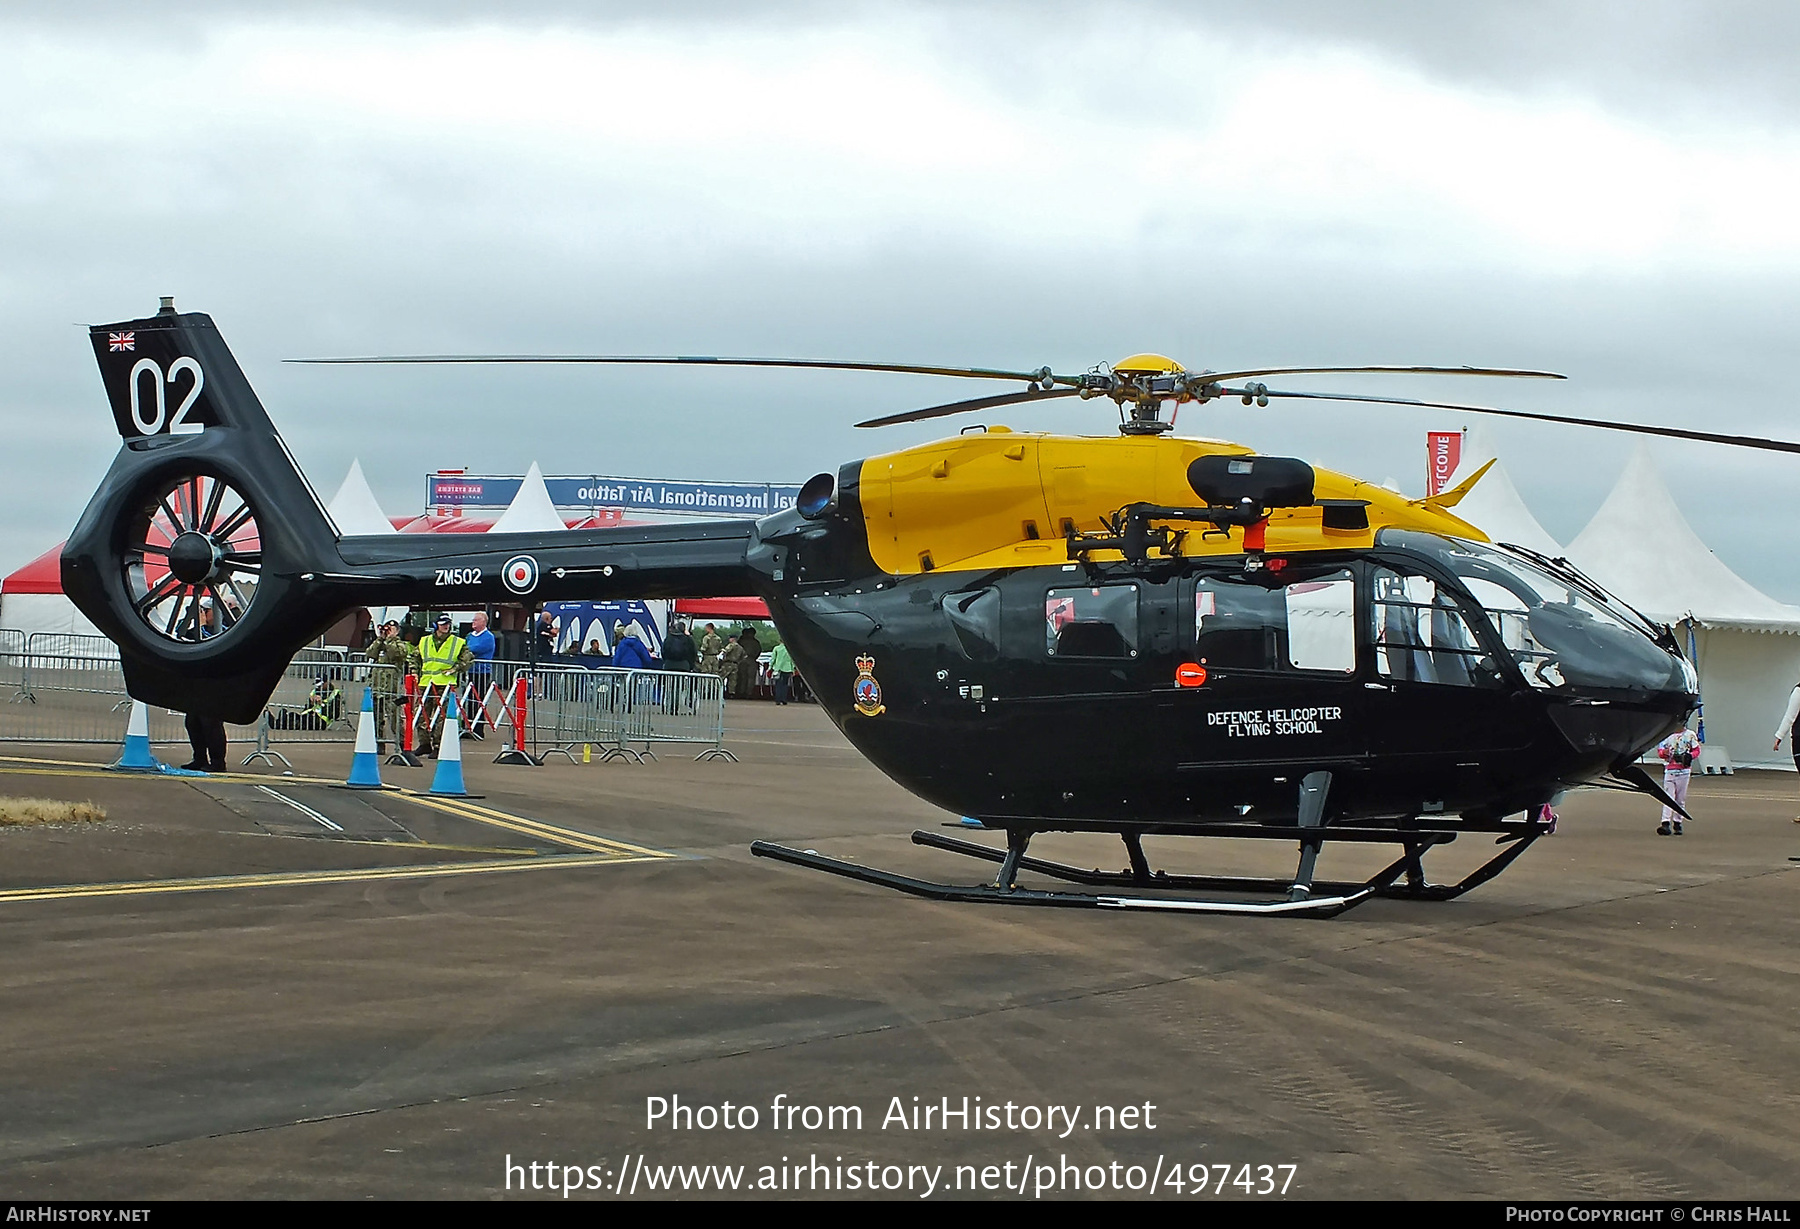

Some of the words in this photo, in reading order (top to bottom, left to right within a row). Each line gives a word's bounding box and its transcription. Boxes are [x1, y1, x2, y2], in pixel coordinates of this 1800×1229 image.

[130, 356, 204, 435] 02
[435, 568, 482, 586] ZM502
[1207, 710, 1263, 726] DEFENCE
[1267, 706, 1342, 723] HELICOPTER
[1228, 724, 1271, 737] FLYING
[1275, 720, 1323, 735] SCHOOL
